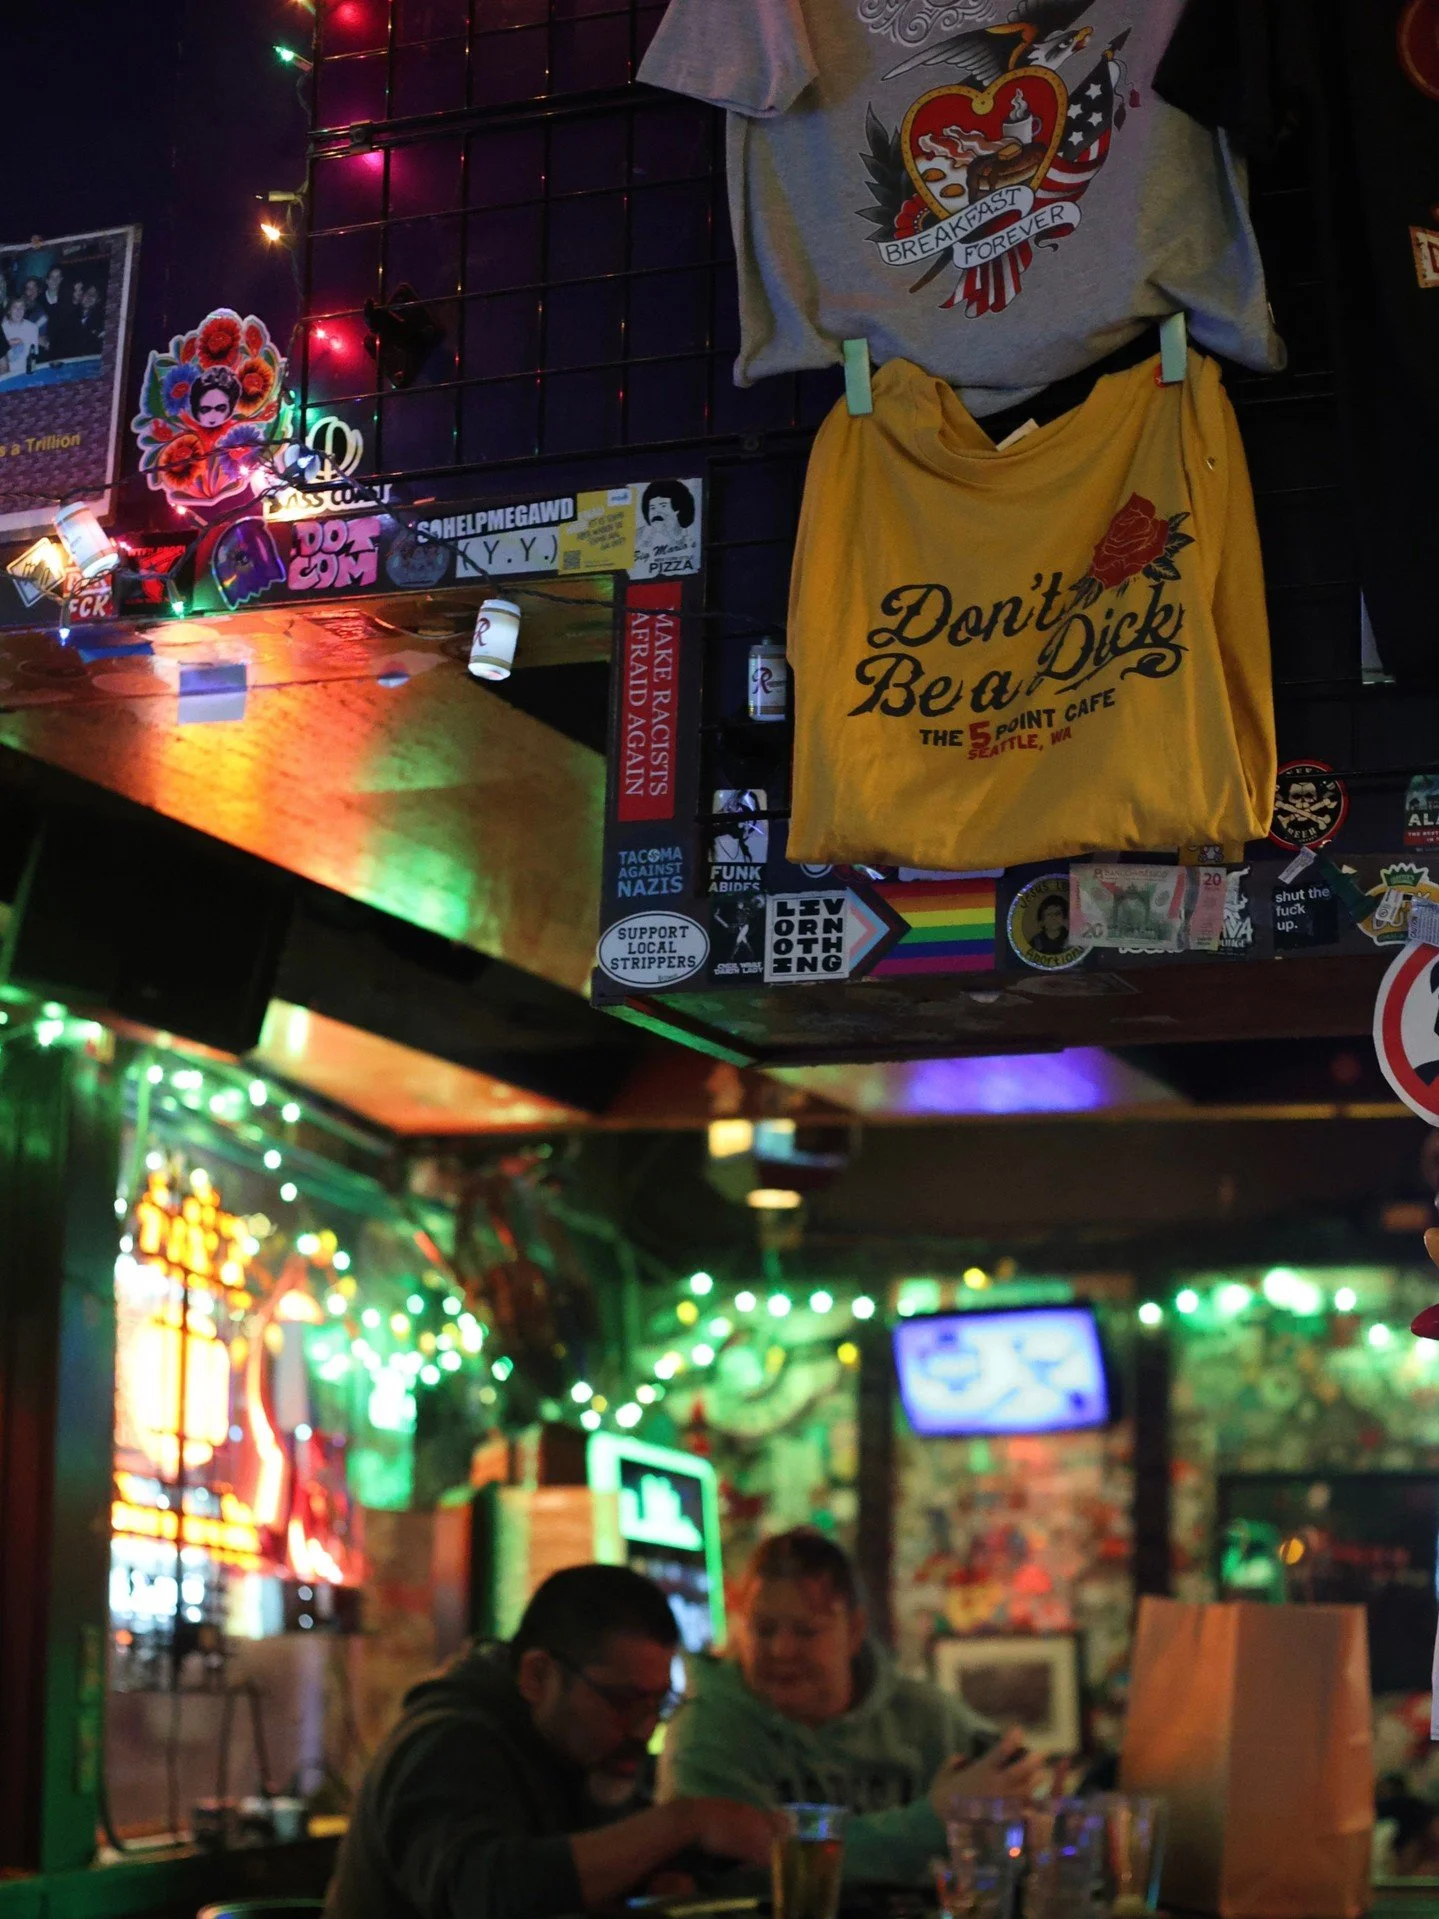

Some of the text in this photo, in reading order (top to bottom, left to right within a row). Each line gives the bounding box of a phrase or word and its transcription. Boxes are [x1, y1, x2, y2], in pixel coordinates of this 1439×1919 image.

[885, 187, 1021, 263] BREAKFAST
[964, 205, 1065, 265] FOREVER
[11, 443, 21, 456] a
[24, 432, 82, 453] Trillion
[296, 517, 381, 556] DOT
[288, 550, 380, 590] COM
[649, 560, 694, 574] PIZZA
[866, 570, 1065, 650] Don't
[847, 580, 1190, 718] Be a Dick
[623, 611, 650, 797] AFRAID AGAIN
[648, 607, 676, 797] MAKE RACISTS
[919, 687, 1116, 749] THE 5 POINT CAFE
[967, 726, 1072, 760] SEATTLE, WA
[617, 846, 683, 865] TACOMA
[618, 861, 683, 879] AGAINST
[709, 864, 762, 881] FUNK
[1203, 872, 1222, 887] 20
[616, 874, 684, 898] NAZIS
[707, 880, 762, 893] ABIDES
[1275, 885, 1331, 903] shut the
[1275, 902, 1307, 917] fuck
[618, 925, 690, 940] SUPPORT
[1276, 919, 1299, 935] up.
[628, 940, 677, 955] LOCAL
[610, 955, 696, 970] STRIPPERS
